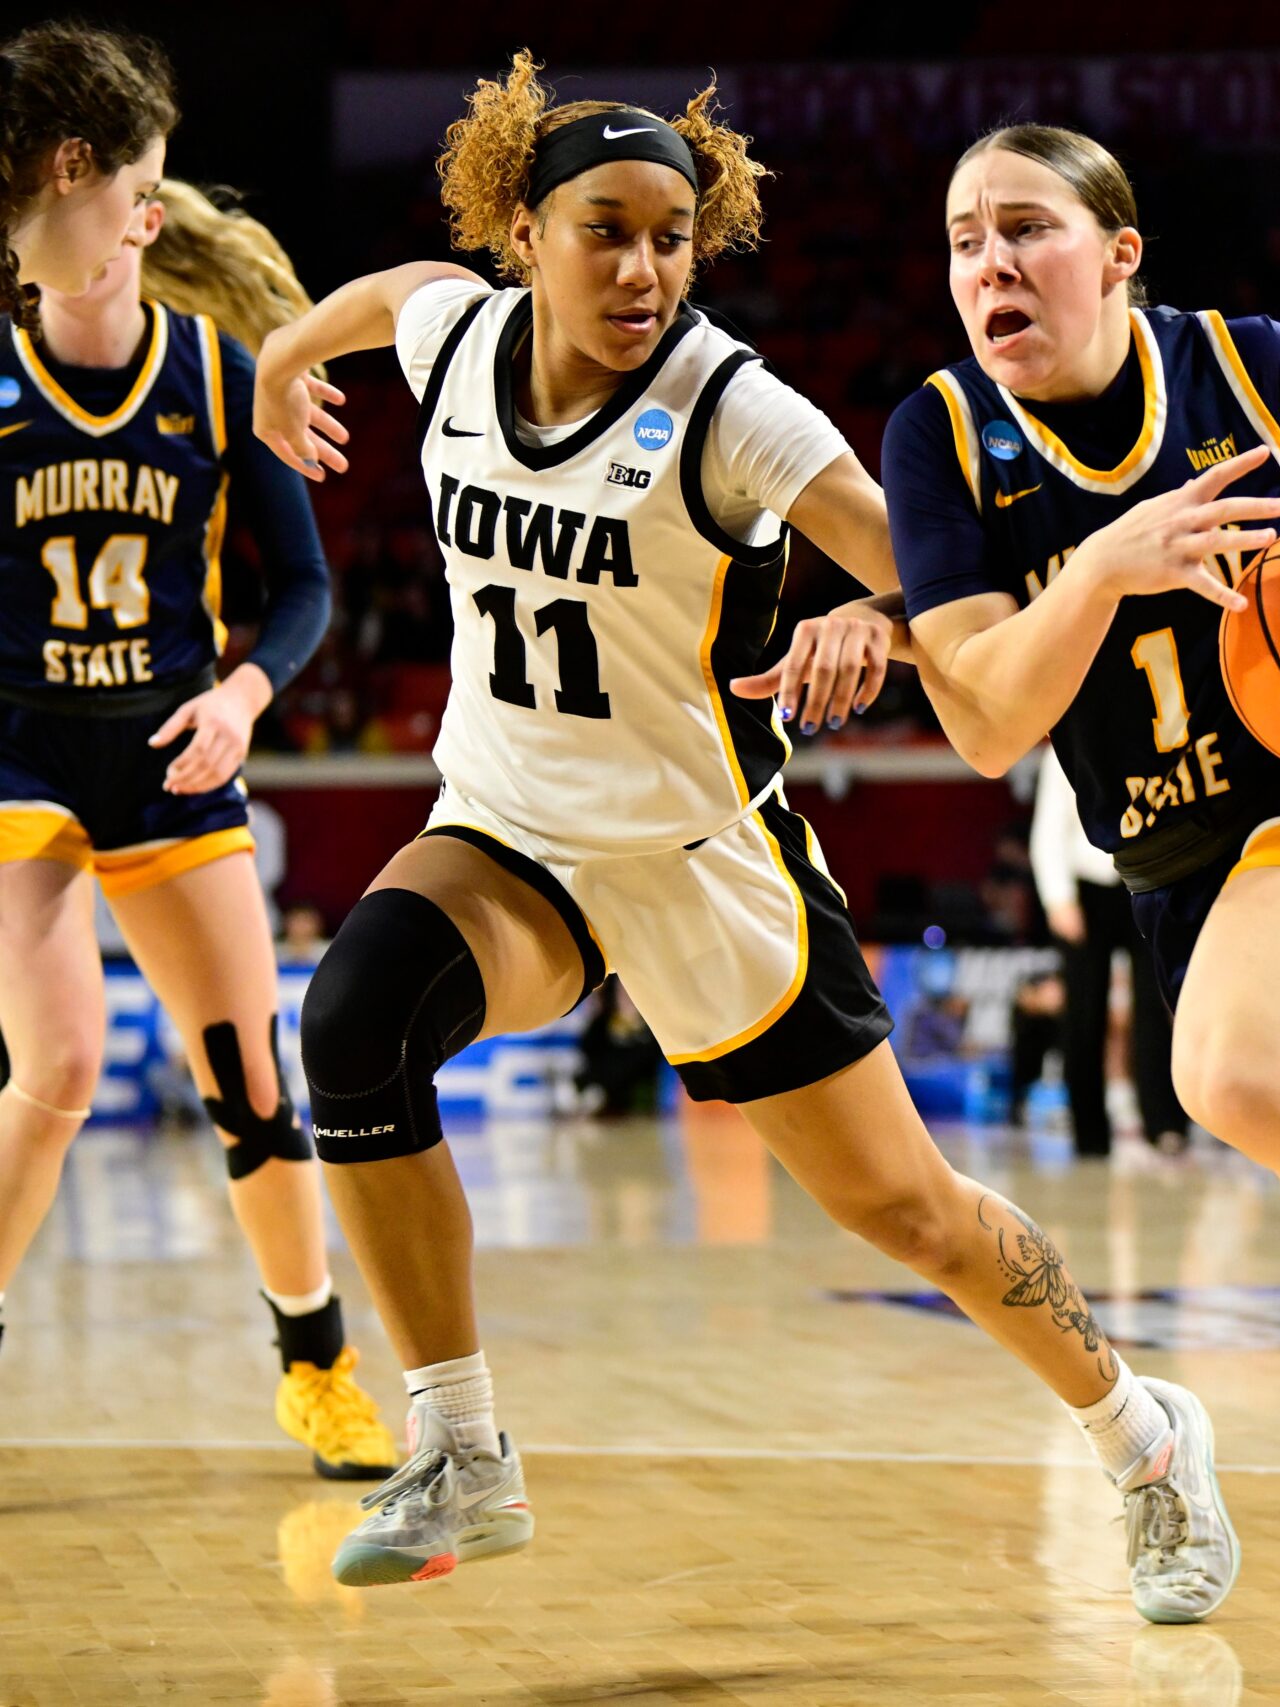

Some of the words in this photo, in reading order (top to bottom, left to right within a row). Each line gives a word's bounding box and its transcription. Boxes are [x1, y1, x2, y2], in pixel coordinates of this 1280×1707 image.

[638, 427, 668, 440] NCAA
[1185, 432, 1238, 471] VALLEY
[15, 459, 179, 527] MURRAY
[437, 472, 639, 587] IOWA
[41, 534, 150, 630] 14
[42, 638, 154, 686] STATE
[472, 583, 612, 719] 11
[1131, 627, 1191, 753] 1
[317, 1124, 395, 1138] MUELLER
